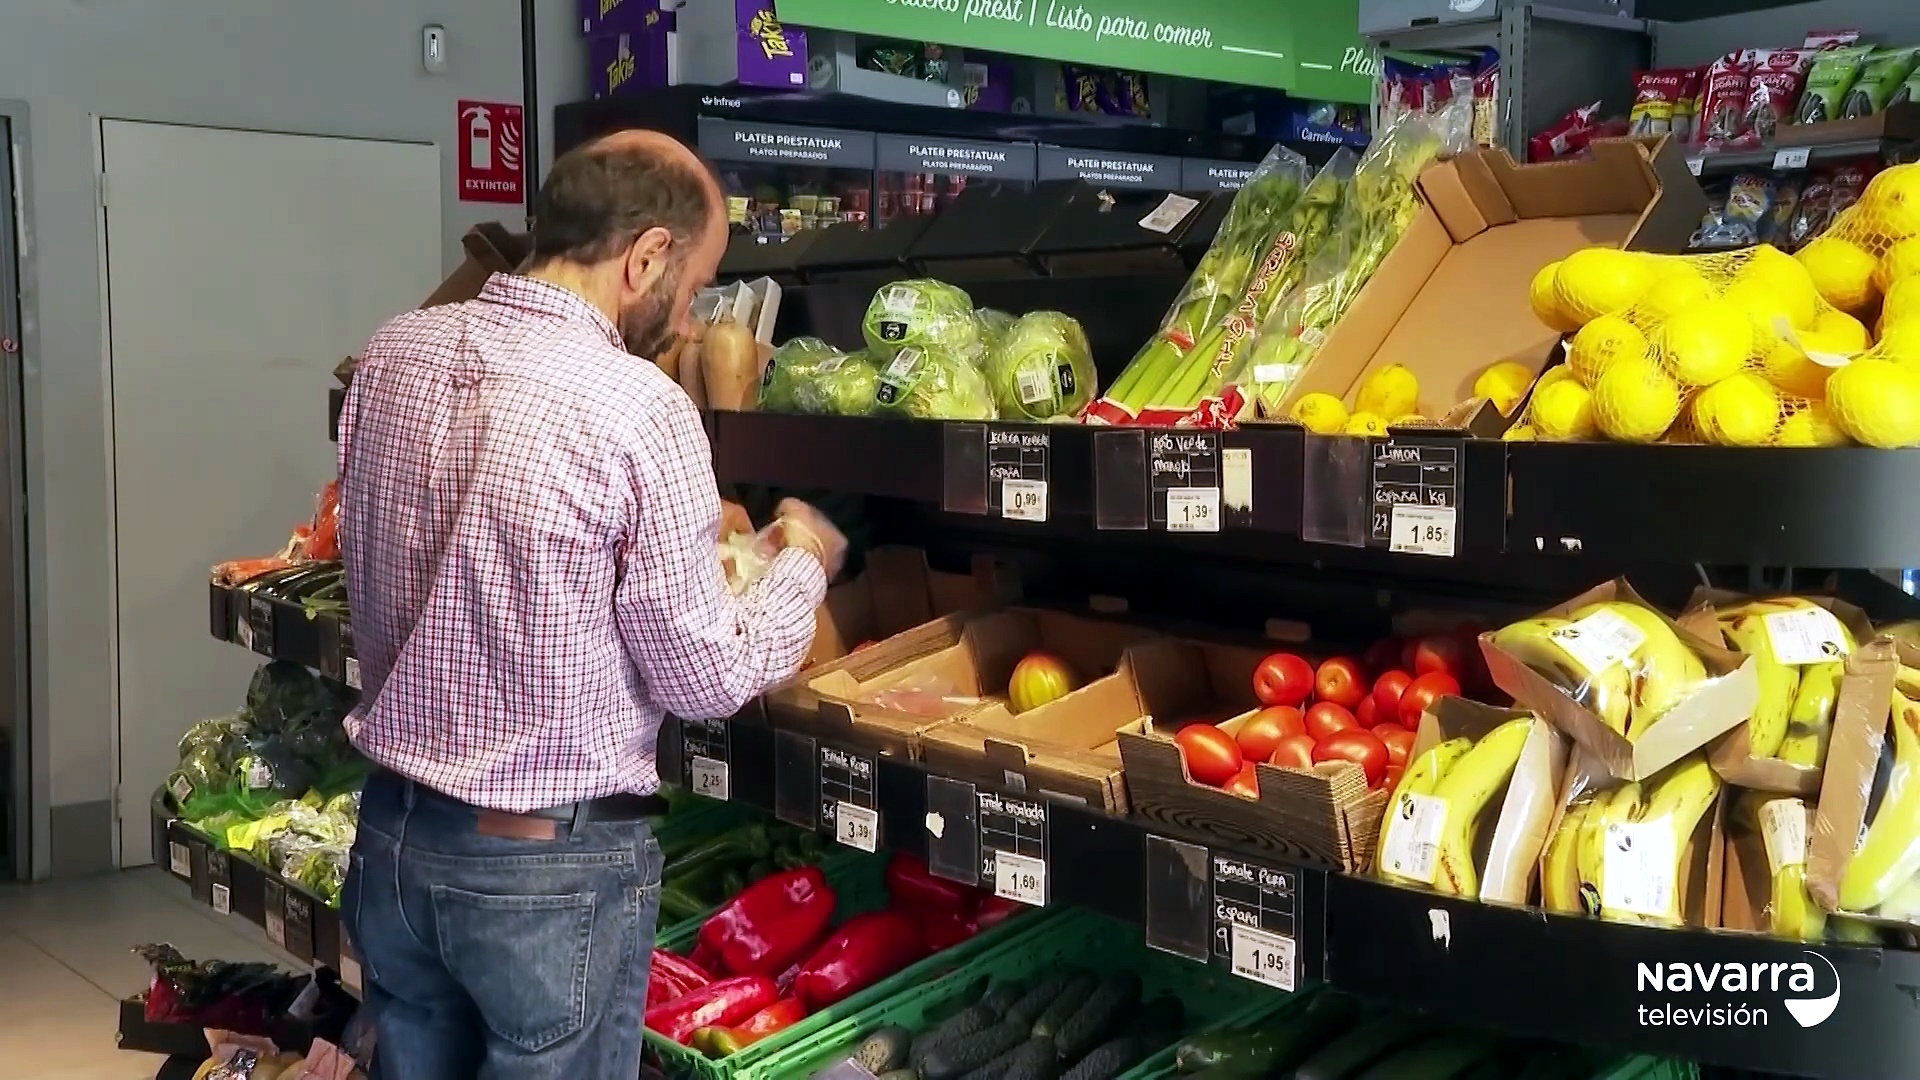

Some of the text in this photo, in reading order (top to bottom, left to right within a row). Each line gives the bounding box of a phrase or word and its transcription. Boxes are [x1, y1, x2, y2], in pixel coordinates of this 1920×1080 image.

[1047, 0, 1092, 31] Listo
[1096, 15, 1149, 41] para
[1154, 21, 1213, 48] comer
[735, 131, 842, 150] PLATER PRESTATUAK
[909, 145, 1006, 162] PLATER PRESTATUAK
[1068, 158, 1154, 172] PLATER PRESTATUAK
[1208, 168, 1238, 178] PLATER
[465, 179, 517, 191] EXTINTOR
